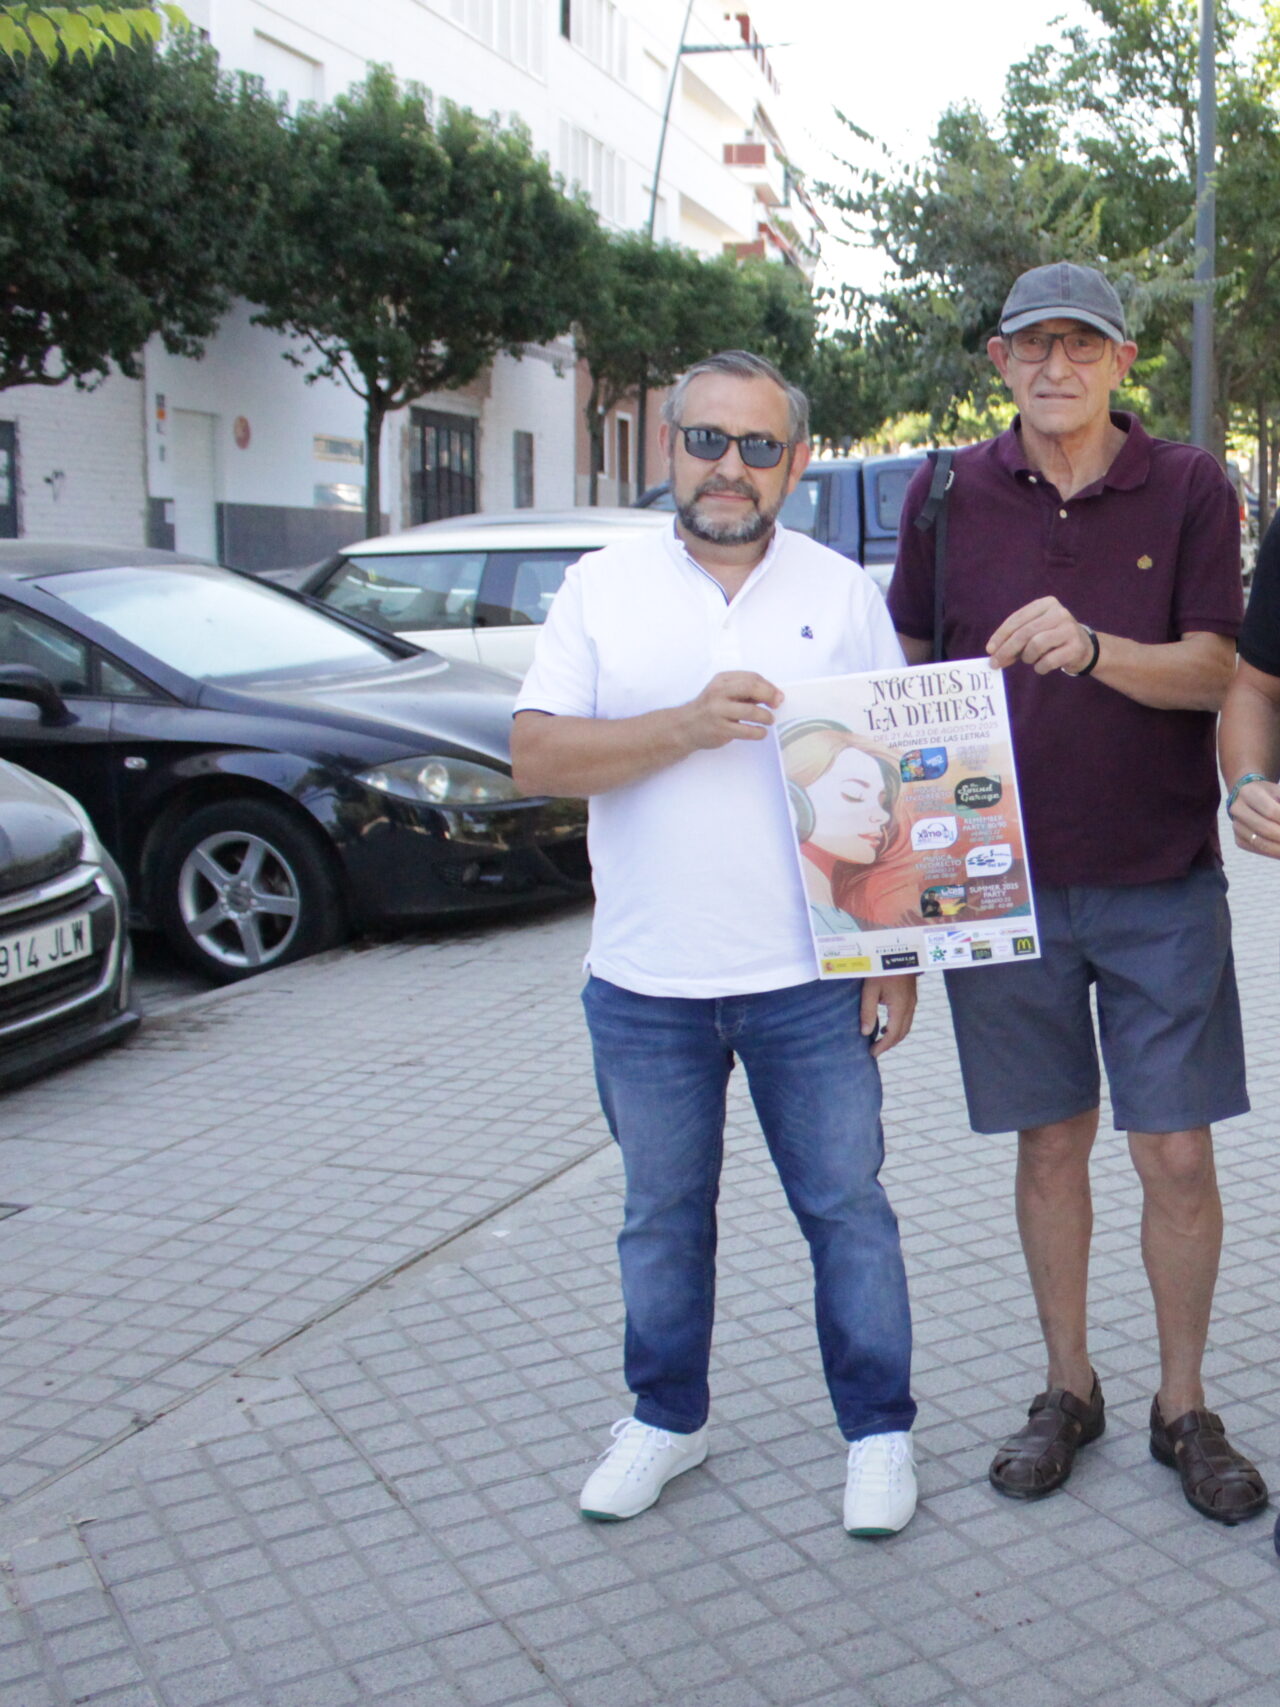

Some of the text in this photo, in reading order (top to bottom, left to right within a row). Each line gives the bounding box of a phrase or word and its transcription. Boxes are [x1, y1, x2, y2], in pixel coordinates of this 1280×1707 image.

[867, 669, 993, 706] NOCHES DE
[863, 693, 996, 733] LA DEHESA
[873, 733, 889, 742] DEL
[940, 723, 977, 734] AGOSTO
[887, 737, 928, 748] JARDINES
[943, 734, 959, 742] LAS
[960, 730, 990, 740] LETRAS
[957, 782, 993, 794] Sound
[960, 790, 1000, 804] Garage
[969, 884, 1001, 893] SUMMER
[983, 890, 1006, 898] PARTY
